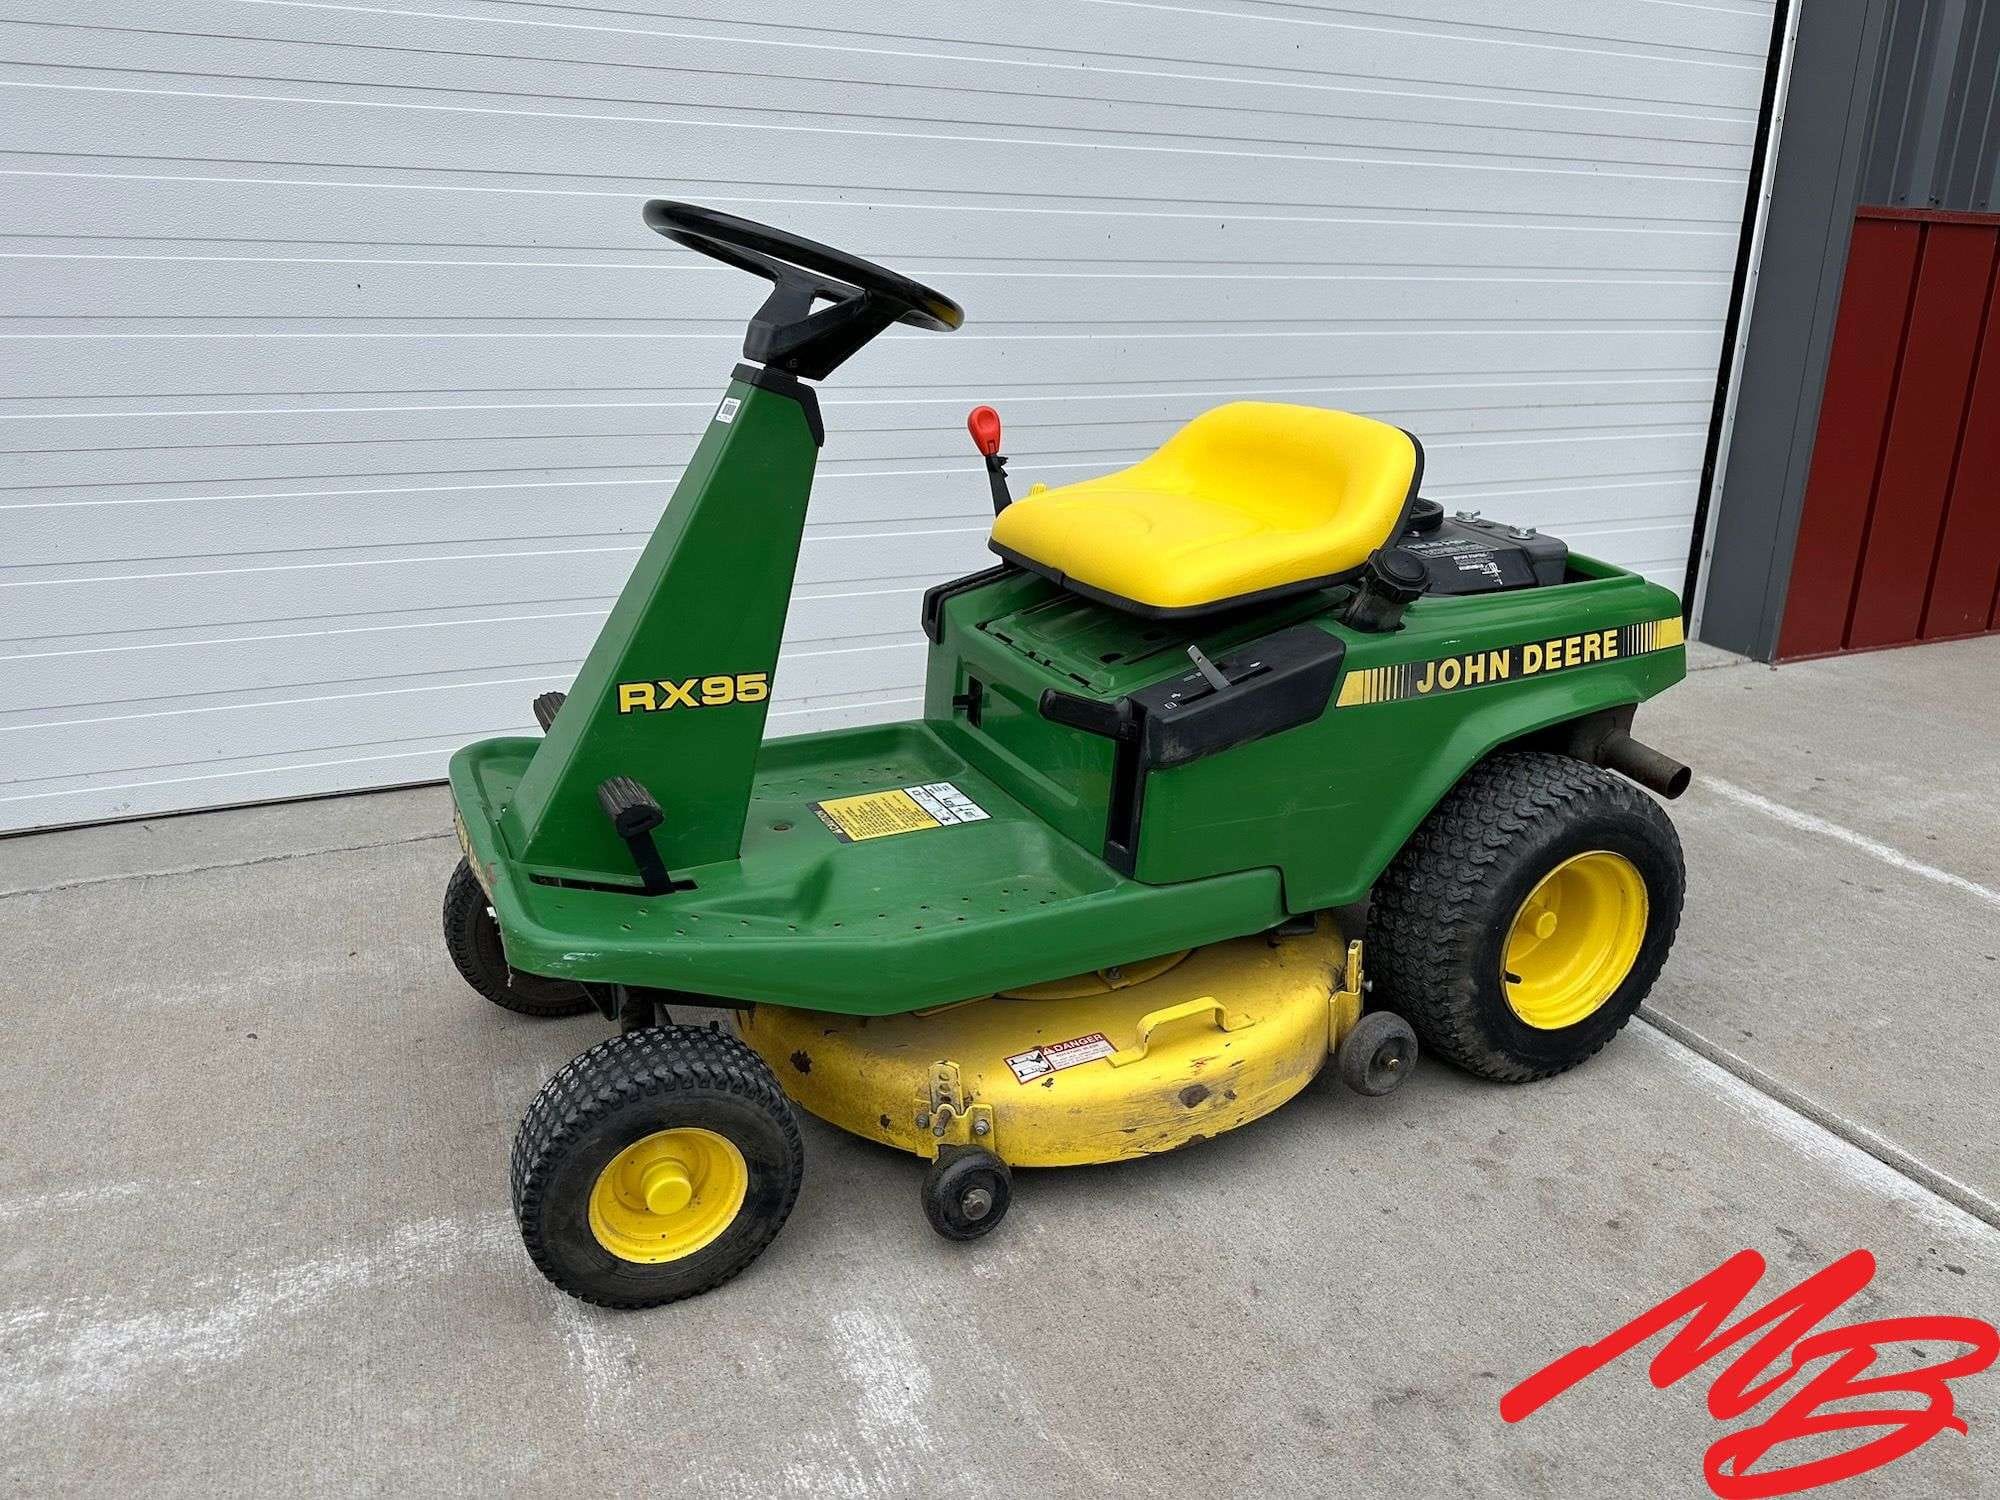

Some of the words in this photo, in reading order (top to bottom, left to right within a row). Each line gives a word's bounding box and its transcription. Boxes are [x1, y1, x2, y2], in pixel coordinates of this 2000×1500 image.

[1416, 649, 1509, 694] JOHN
[1522, 629, 1618, 675] DEERE
[618, 673, 768, 713] RX95
[1054, 1034, 1103, 1052] DANGER
